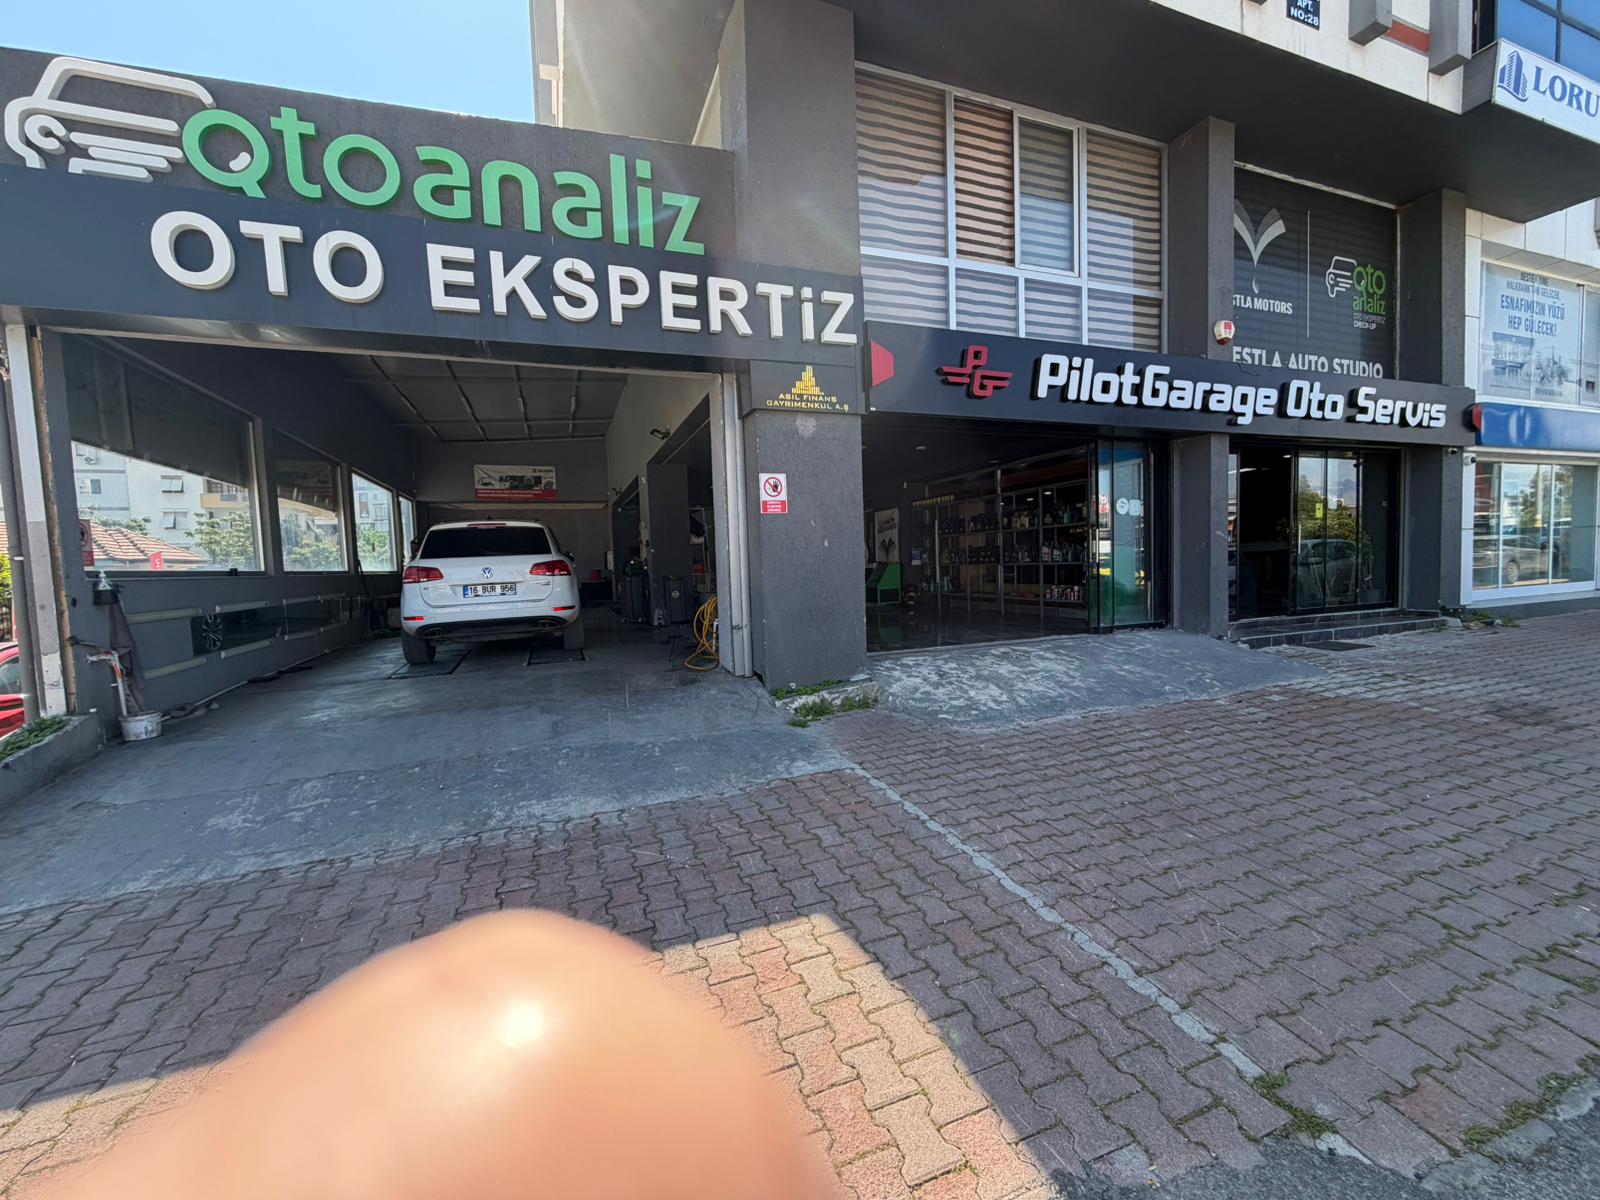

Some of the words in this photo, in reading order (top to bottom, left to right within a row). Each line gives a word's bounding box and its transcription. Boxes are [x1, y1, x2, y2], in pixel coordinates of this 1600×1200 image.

[1290, 6, 1319, 26] NO:28
[1532, 65, 1600, 117] LORU
[150, 210, 384, 304] OTO
[1253, 297, 1293, 315] MOTORS
[1353, 294, 1386, 315] analiz
[1500, 294, 1546, 317] ESNAFIMIZIN
[1548, 301, 1565, 321] YÜZÜ
[1508, 314, 1522, 331] HEP
[1524, 315, 1557, 338] GÜLECEK!
[1288, 352, 1329, 373] AUTO
[1332, 357, 1384, 379] STUDIO
[1037, 353, 1278, 425] PilotGarage
[1286, 379, 1344, 420] Oto
[1355, 386, 1447, 428] Servis
[469, 586, 479, 595] 16
[482, 586, 497, 595] BUR
[500, 584, 515, 593] 956
